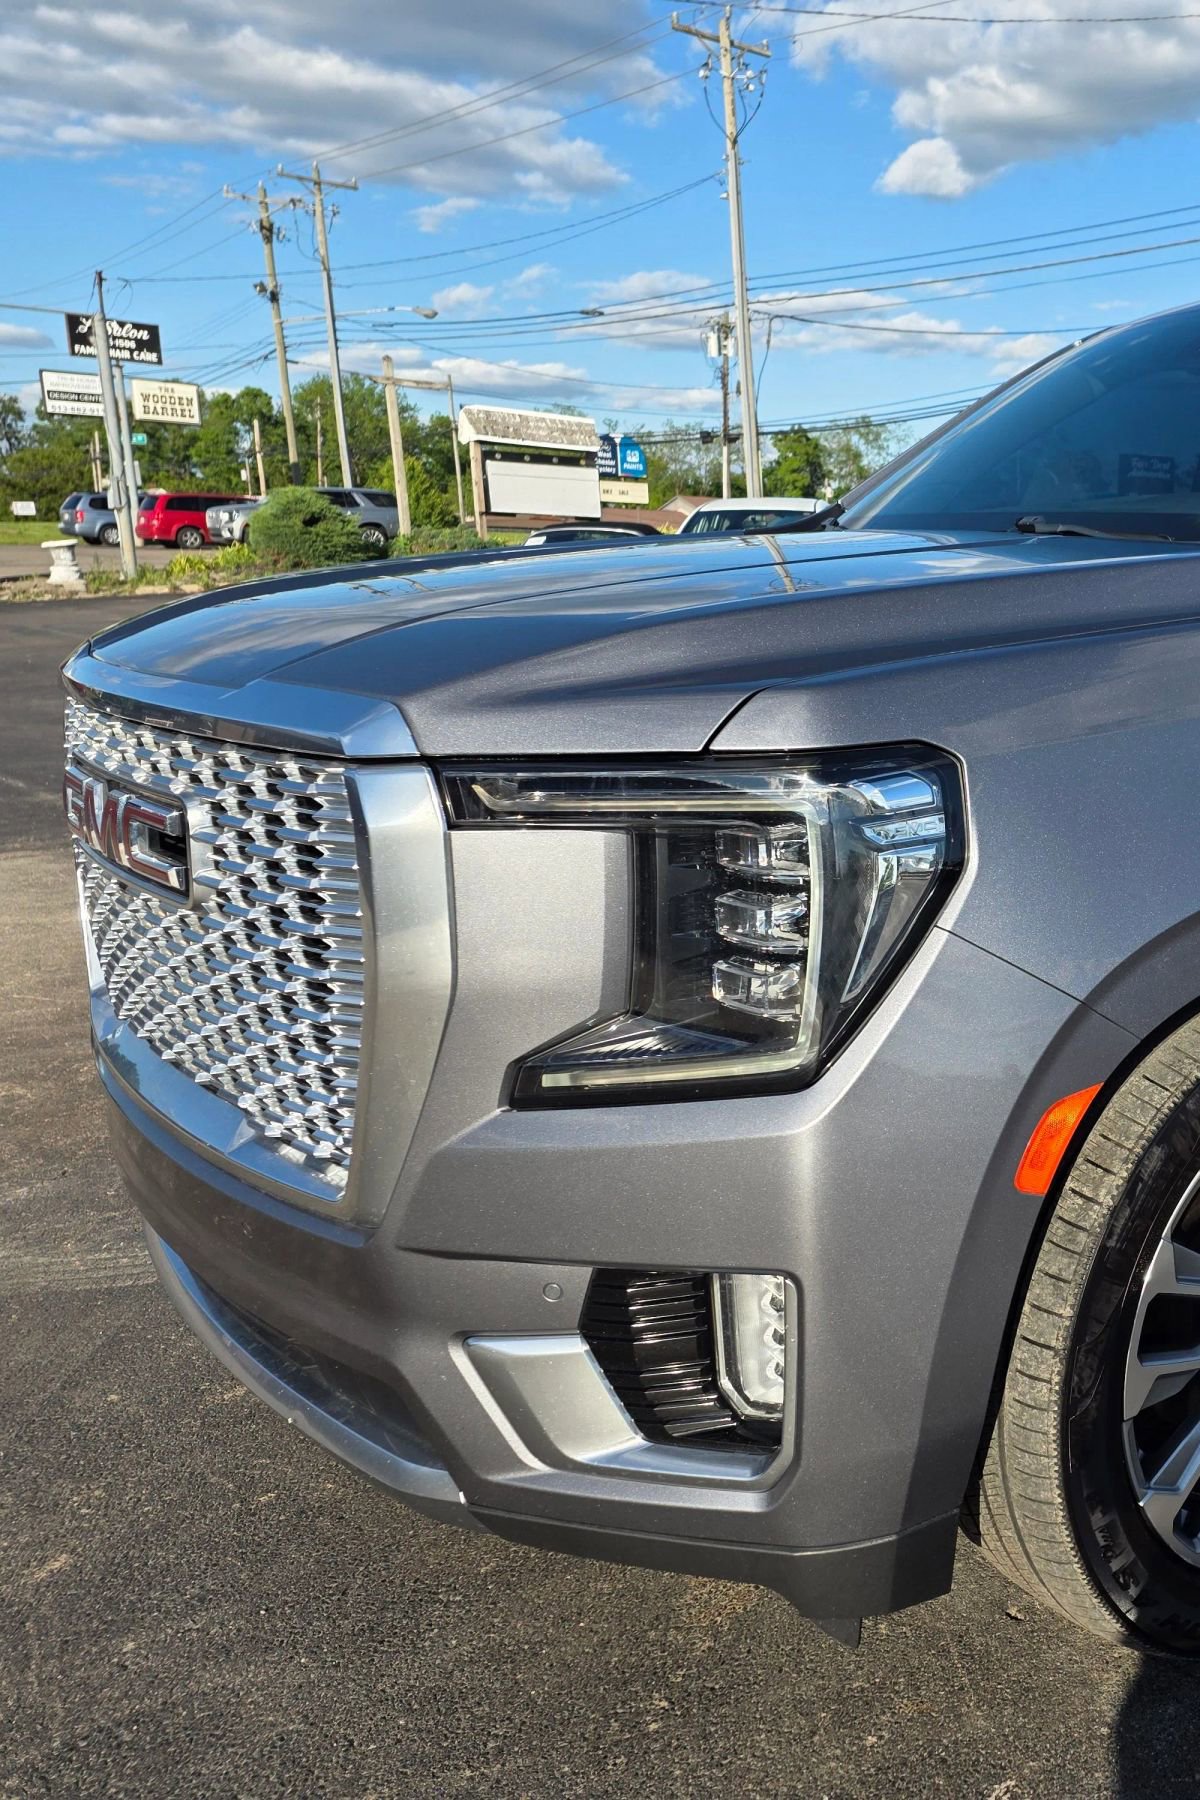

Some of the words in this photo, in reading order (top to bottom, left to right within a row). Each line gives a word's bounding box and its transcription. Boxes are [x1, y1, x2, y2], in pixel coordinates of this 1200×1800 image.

[109, 347, 131, 360] HAIR
[132, 350, 159, 363] CARE
[49, 391, 78, 401] DESIGN
[140, 392, 194, 407] WOODEN
[142, 404, 195, 419] BARREL
[63, 766, 187, 891] GMC
